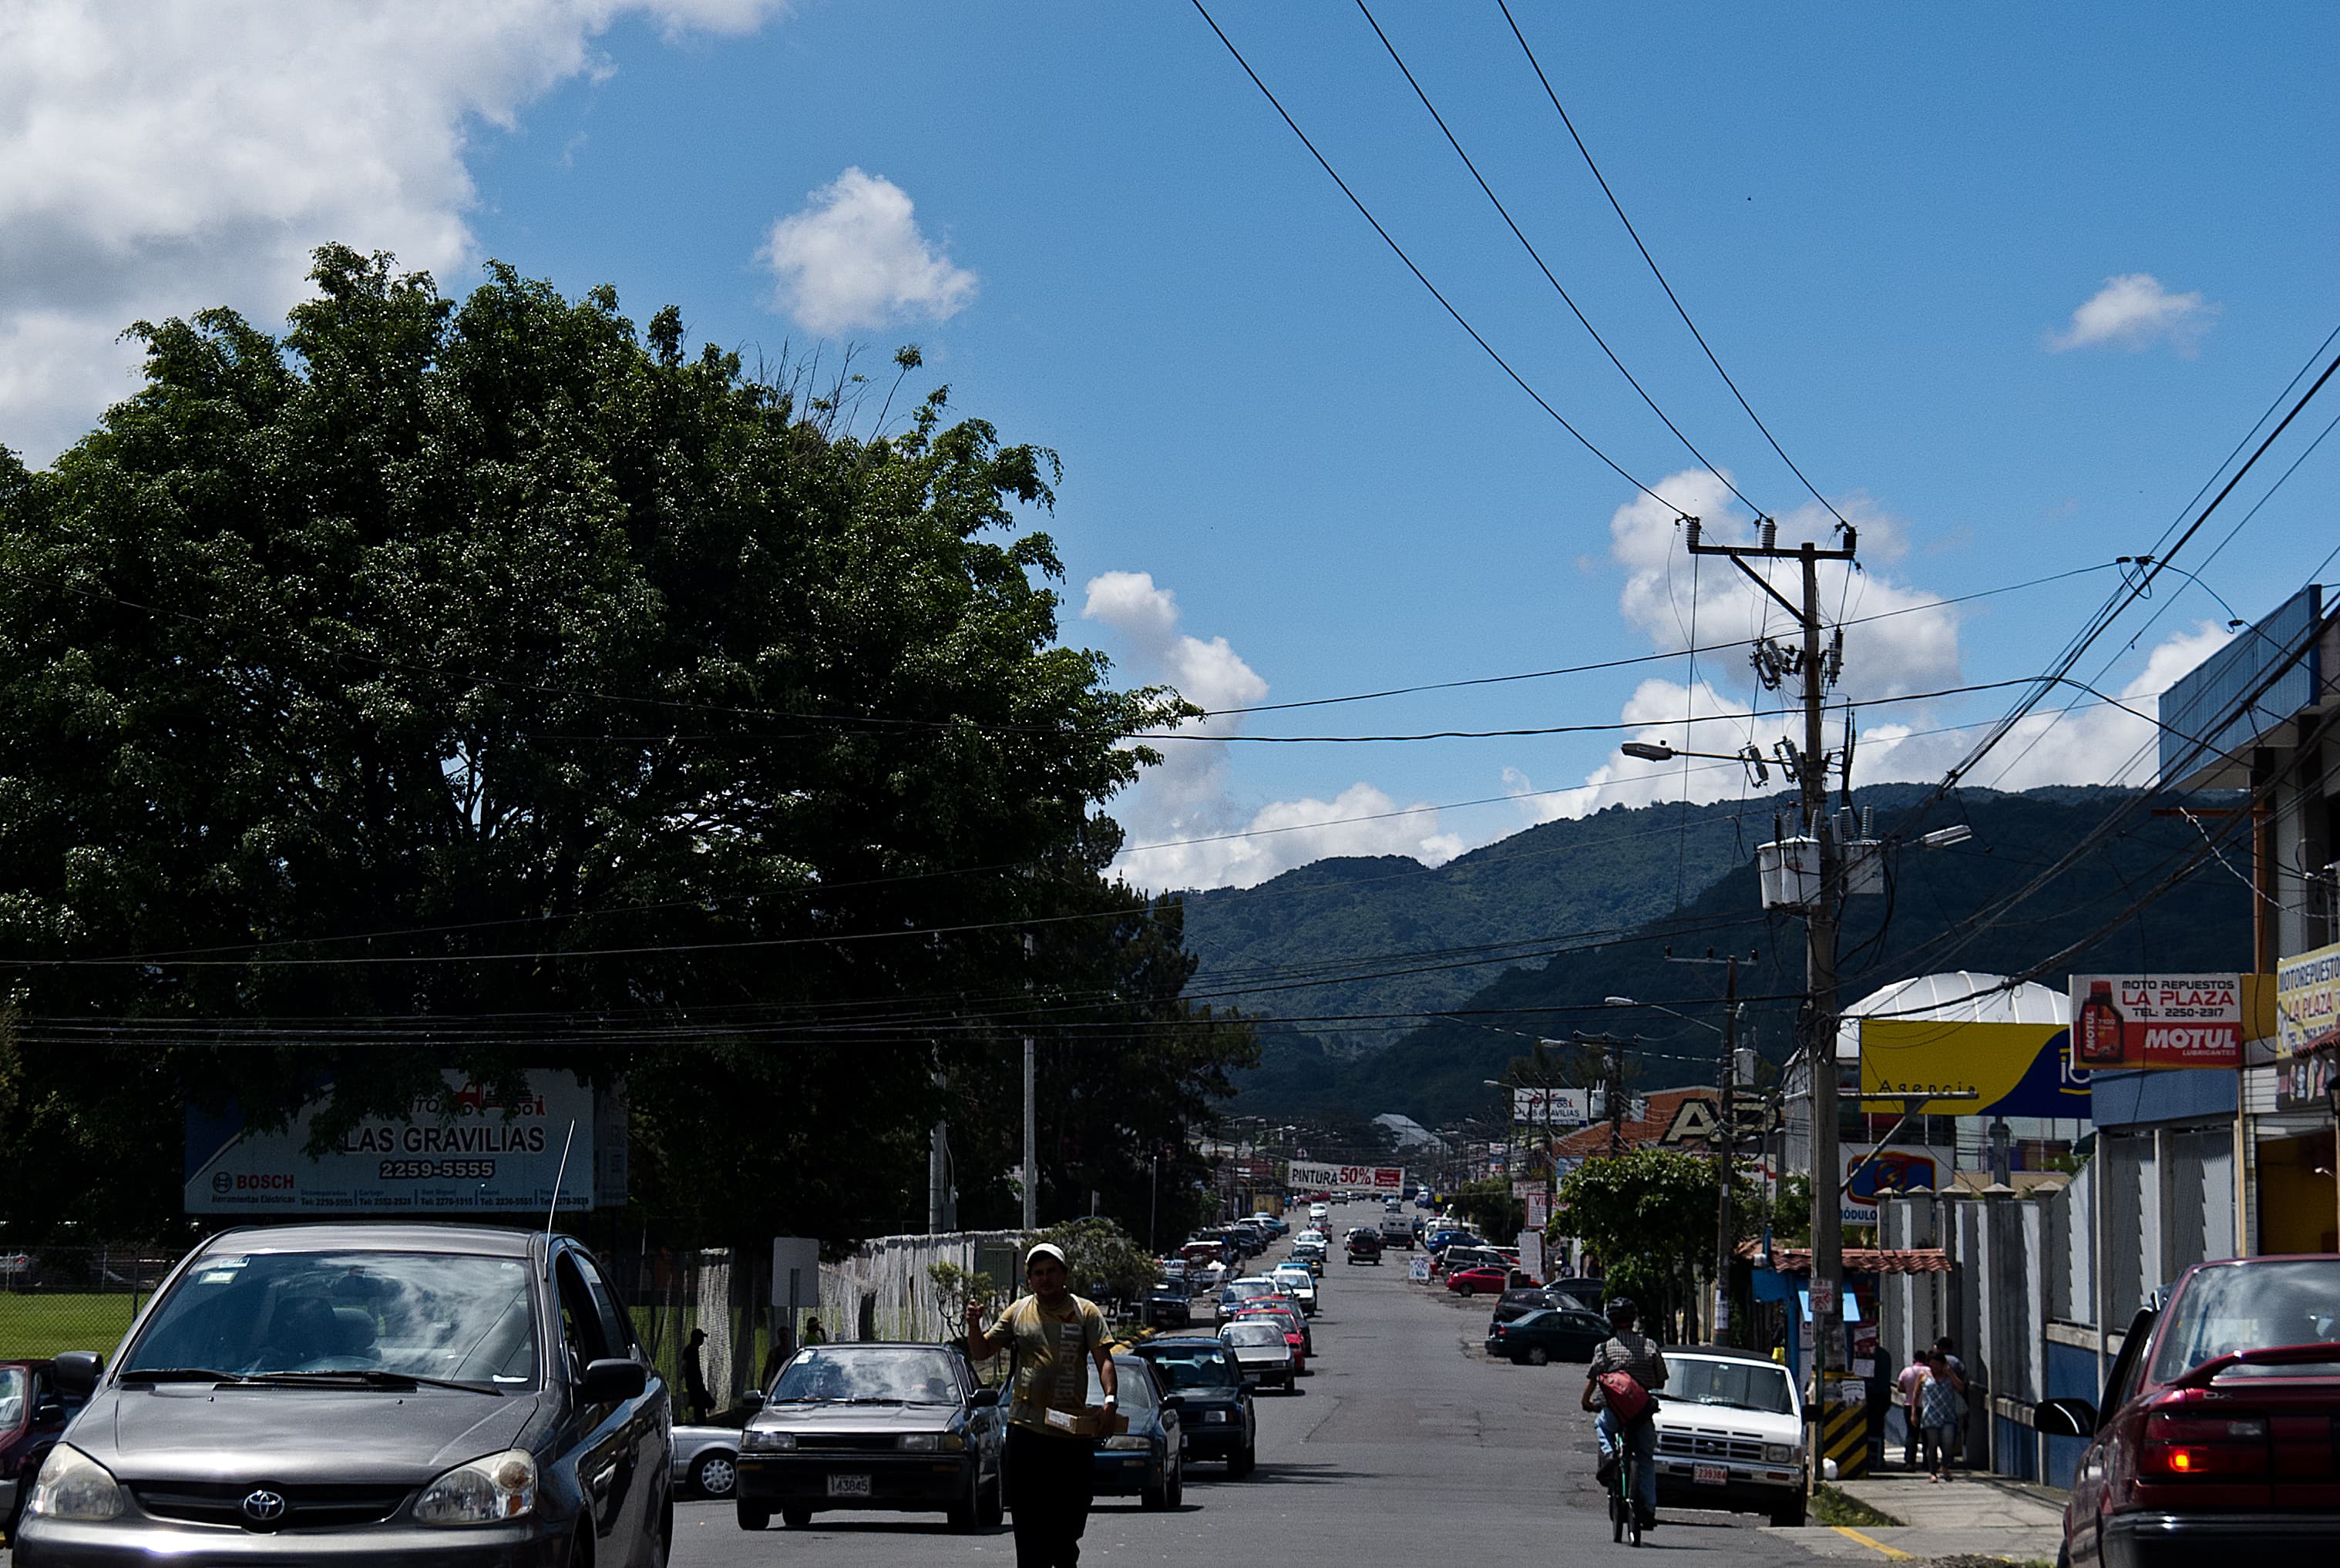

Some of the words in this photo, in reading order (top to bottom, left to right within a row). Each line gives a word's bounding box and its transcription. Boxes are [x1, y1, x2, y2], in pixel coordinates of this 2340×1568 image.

[2122, 981, 2157, 989] MOTO
[2162, 981, 2234, 989] REPUESTOS
[2123, 991, 2151, 1006] LA
[2160, 991, 2234, 1006] PLAZA
[2302, 991, 2333, 1019] PLAZA
[2133, 1009, 2158, 1017] TEL:
[2164, 1009, 2224, 1017] 2250-2317
[2086, 1011, 2095, 1050] MOTUL
[2145, 1029, 2235, 1049] MOTUL
[345, 1127, 394, 1153] LAS
[404, 1127, 545, 1153] GRAVILIAS
[380, 1160, 494, 1178] 2259-5555
[1293, 1168, 1338, 1185] PINTURA
[1340, 1167, 1371, 1185] 50%
[237, 1175, 294, 1188] BOSCH
[2203, 1392, 2233, 1400] DX
[831, 1479, 868, 1492] 143845
